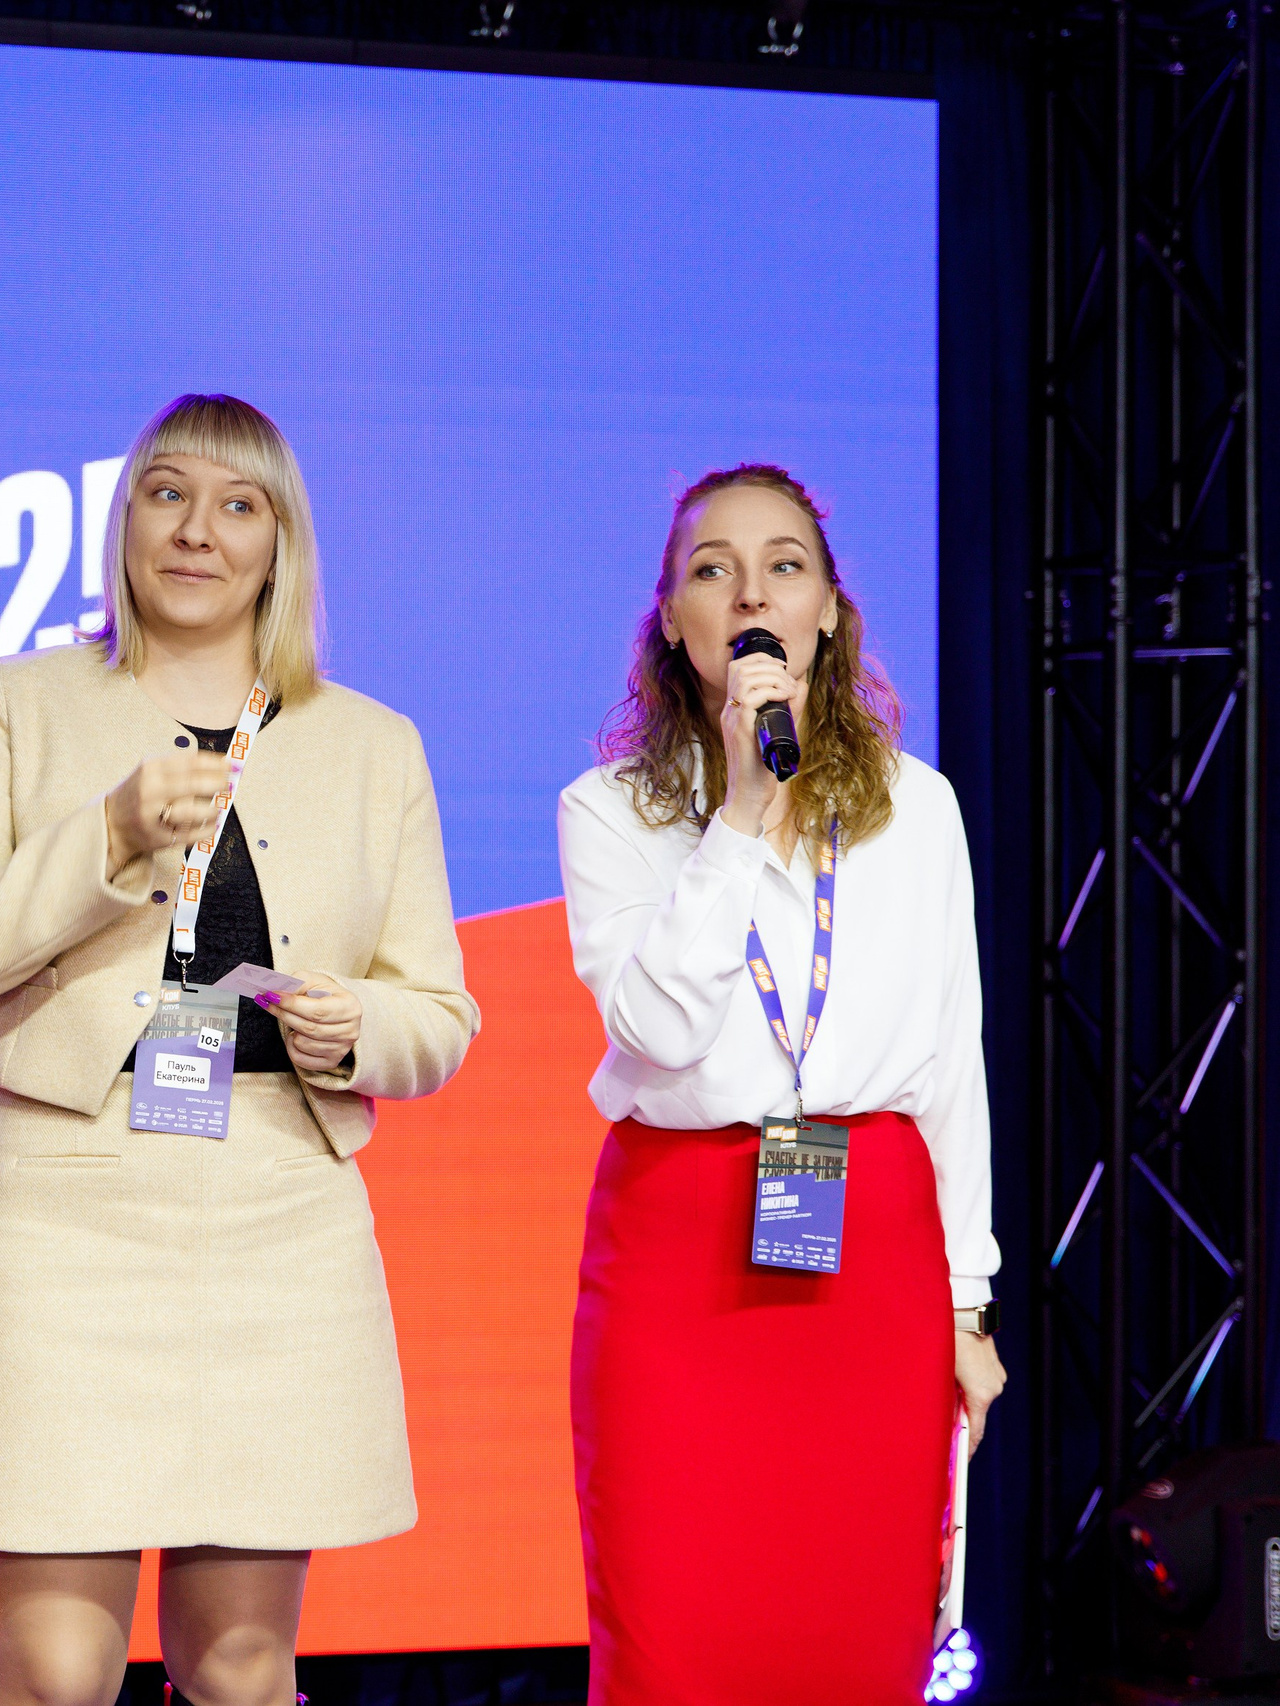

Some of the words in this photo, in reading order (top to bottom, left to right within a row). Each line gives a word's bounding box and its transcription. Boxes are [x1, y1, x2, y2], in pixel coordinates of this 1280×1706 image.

[189, 870, 199, 885] PART
[187, 885, 196, 900] KOM
[149, 1013, 180, 1028] ЧАСТЬЕ
[200, 1034, 220, 1048] 105
[167, 1061, 196, 1072] Пауль
[156, 1071, 205, 1085] Екатерина
[764, 1150, 797, 1165] СЧАСТЬЕ
[762, 1181, 785, 1195] ЕЛЕНА
